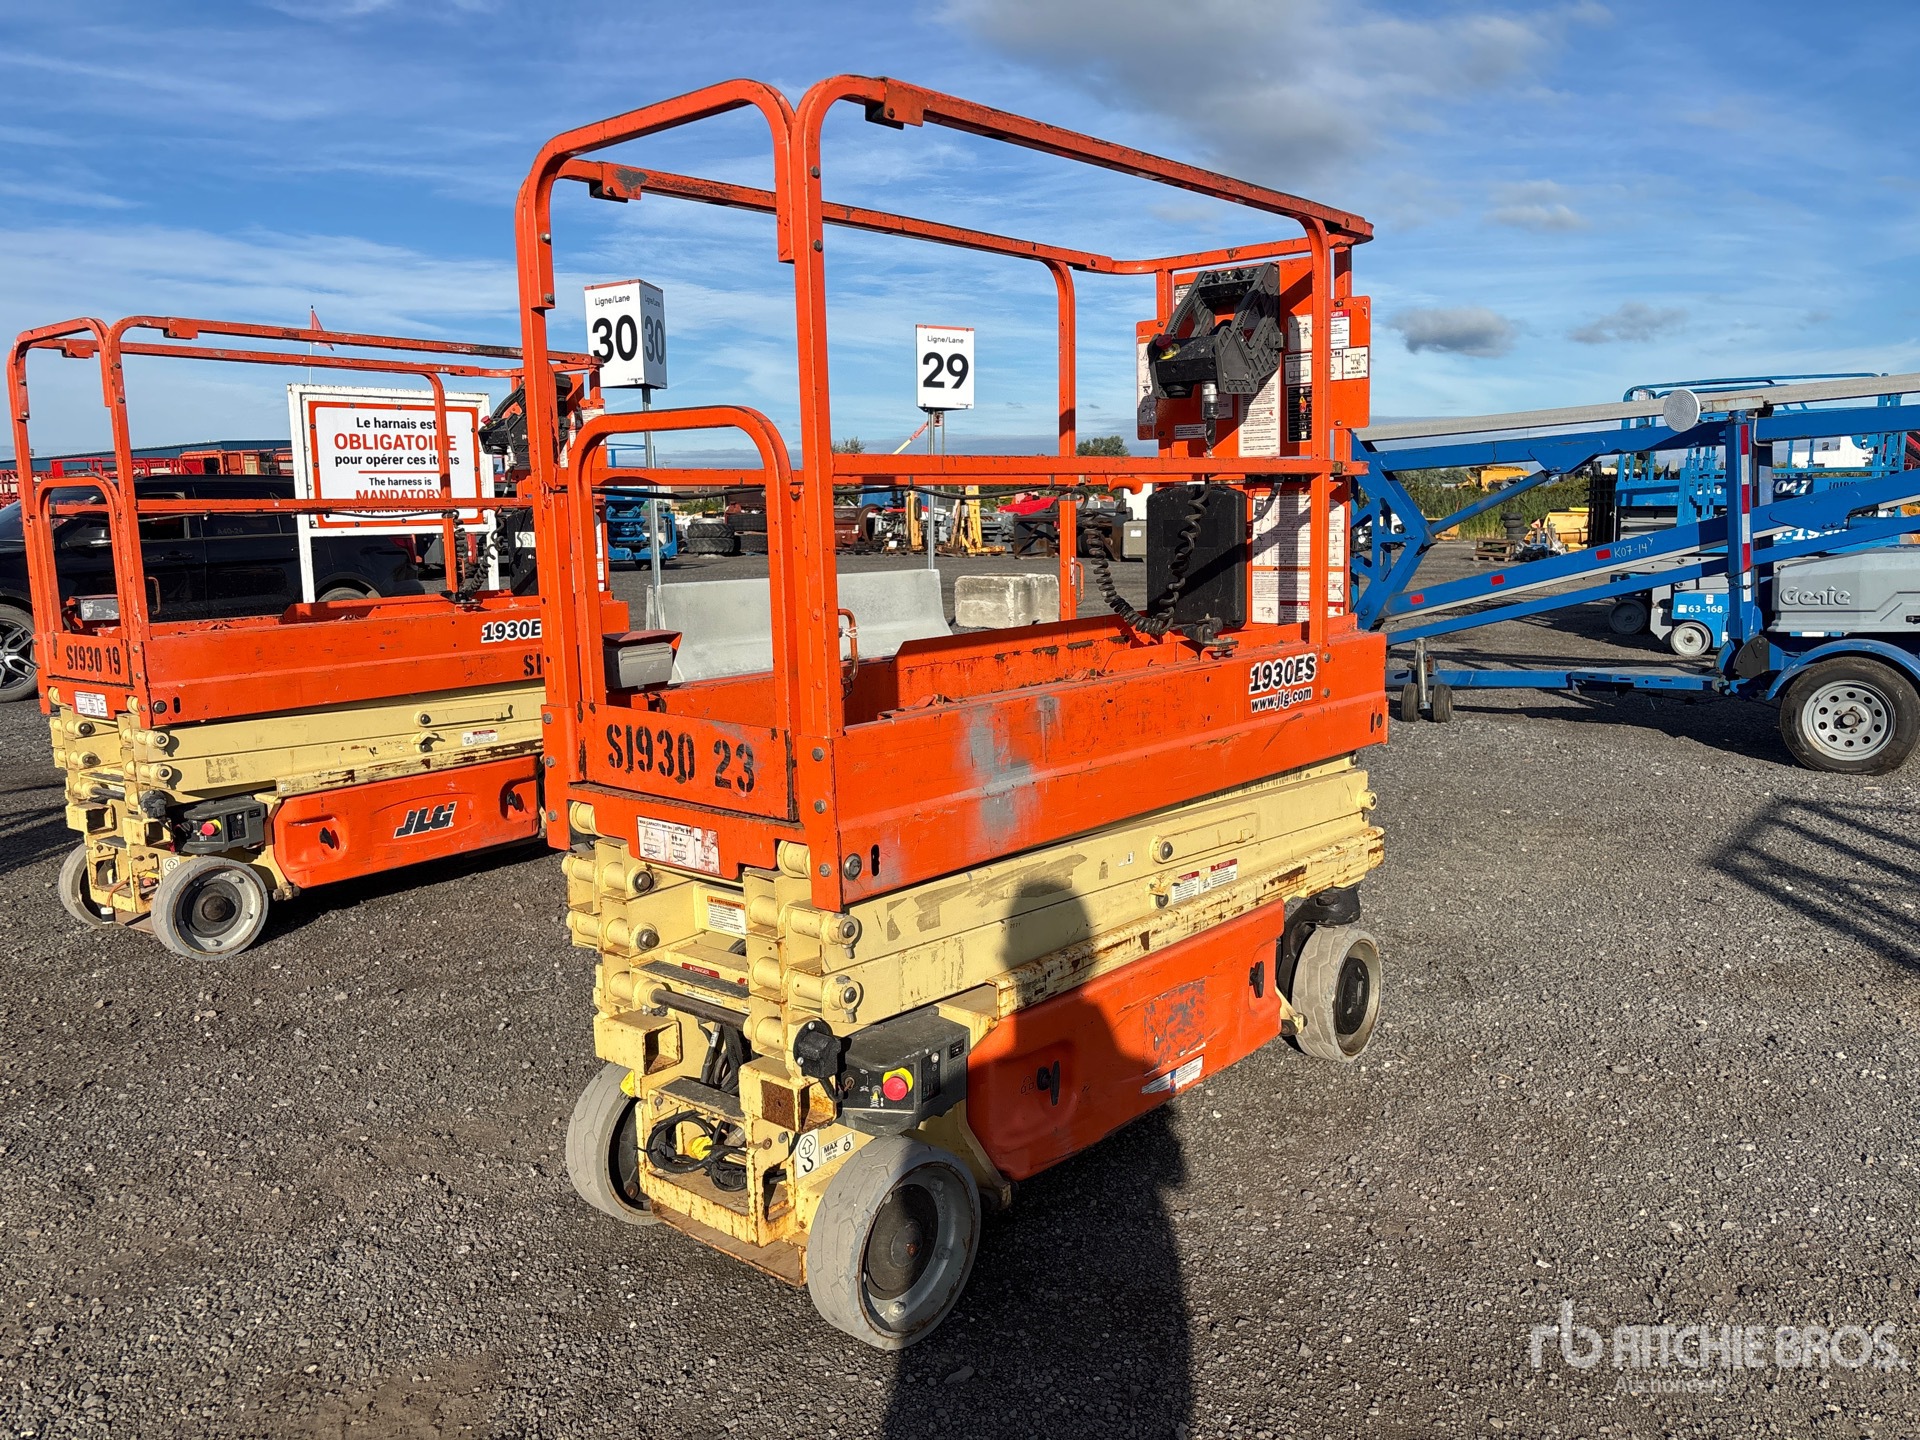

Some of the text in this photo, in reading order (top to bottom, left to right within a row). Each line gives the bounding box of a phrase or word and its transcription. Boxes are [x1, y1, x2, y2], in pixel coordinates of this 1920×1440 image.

[595, 294, 631, 307] Ligne/Lane
[592, 314, 638, 363] 30
[644, 315, 665, 365] 30
[927, 335, 964, 344] Ligne/Lane
[922, 351, 969, 389] 29
[356, 417, 437, 430] Le harnais est
[335, 455, 362, 467] pour
[366, 453, 403, 467] opérer
[407, 456, 426, 465] ces
[369, 477, 432, 486] The harness is
[1613, 542, 1648, 558] K07-14
[1780, 585, 1851, 606] Genie
[1687, 605, 1723, 613] 63-168
[482, 619, 542, 643] 1930E
[105, 645, 121, 675] 19
[1249, 653, 1316, 694] 1930ES
[1251, 687, 1312, 712] www.jlg.com
[713, 738, 755, 793] 23
[393, 801, 457, 839] JLG
[824, 1140, 838, 1154] MAX
